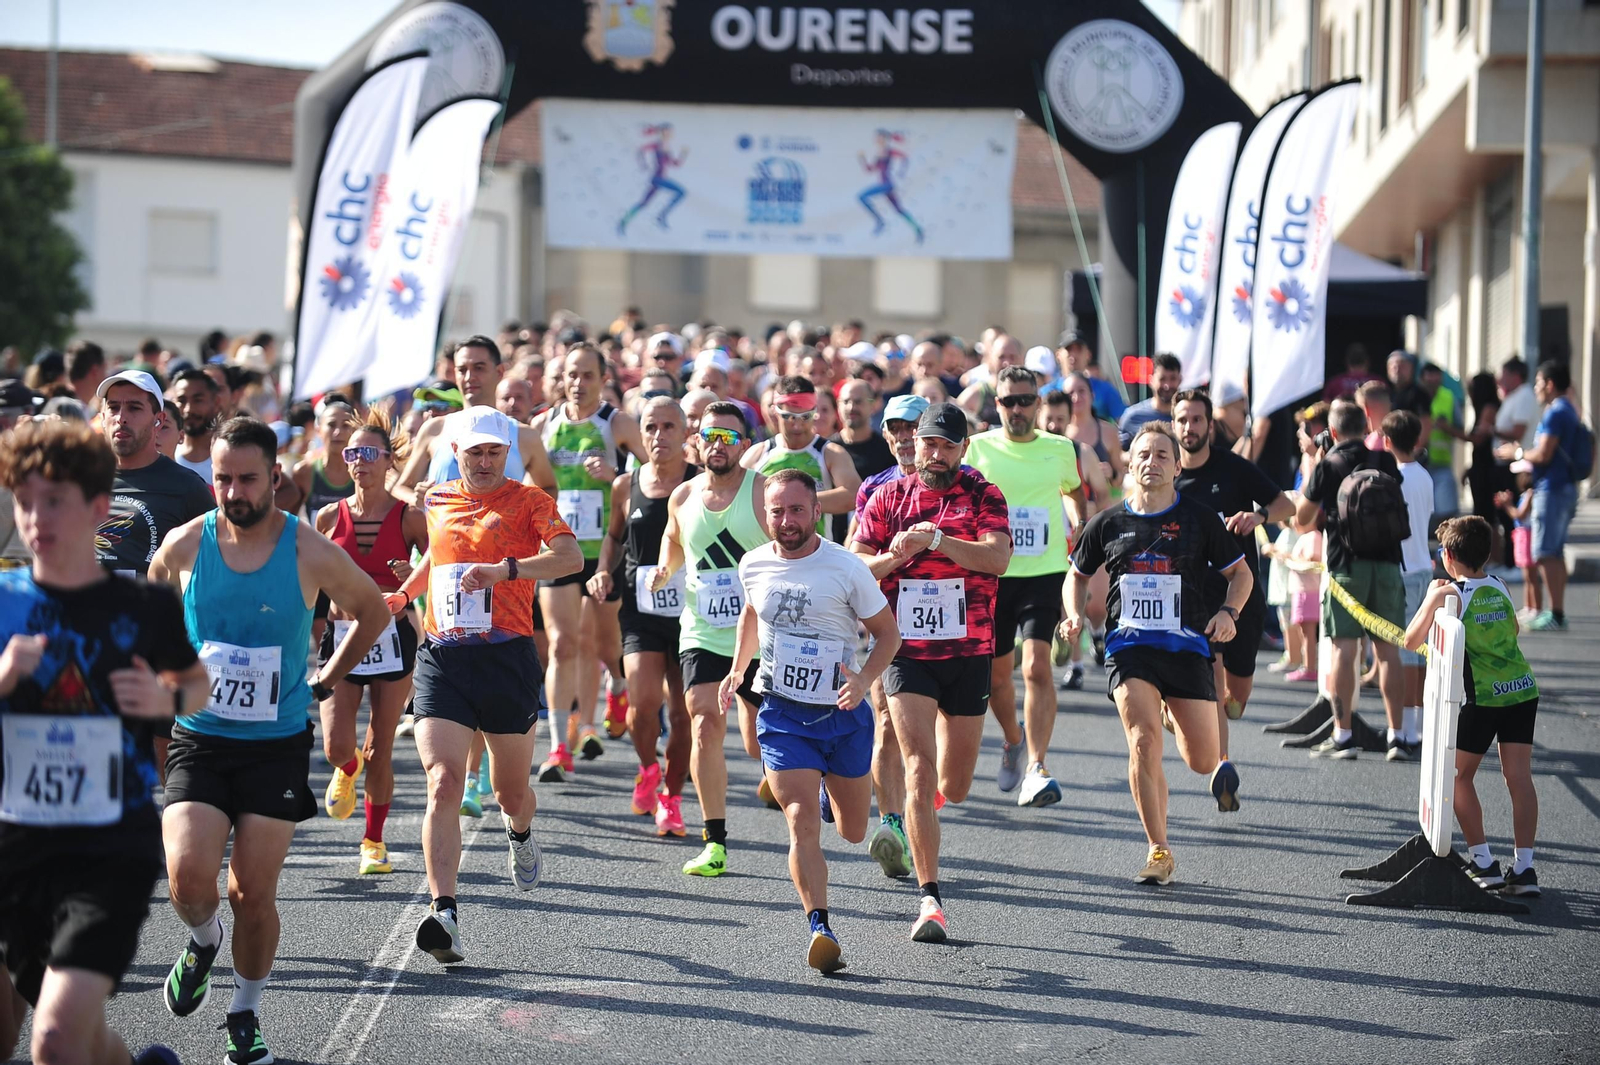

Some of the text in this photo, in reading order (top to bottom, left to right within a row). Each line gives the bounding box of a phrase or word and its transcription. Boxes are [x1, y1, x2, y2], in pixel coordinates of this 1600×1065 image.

[711, 6, 974, 53] OURENSE
[791, 64, 893, 87] Deportes
[326, 172, 371, 245] chc
[395, 191, 433, 260] chc
[1271, 194, 1311, 269] chc
[1174, 213, 1202, 274] chc
[114, 495, 134, 504] MEDIO
[149, 525, 158, 544] GRAN
[1010, 528, 1034, 546] 89
[652, 588, 679, 609] 193
[708, 596, 740, 618] 449
[1132, 600, 1163, 620] 200
[913, 607, 944, 629] 341
[235, 669, 265, 678] GARCIA
[794, 656, 815, 665] EDGAR
[210, 677, 255, 708] 473
[783, 664, 823, 693] 687
[24, 763, 87, 806] 457
